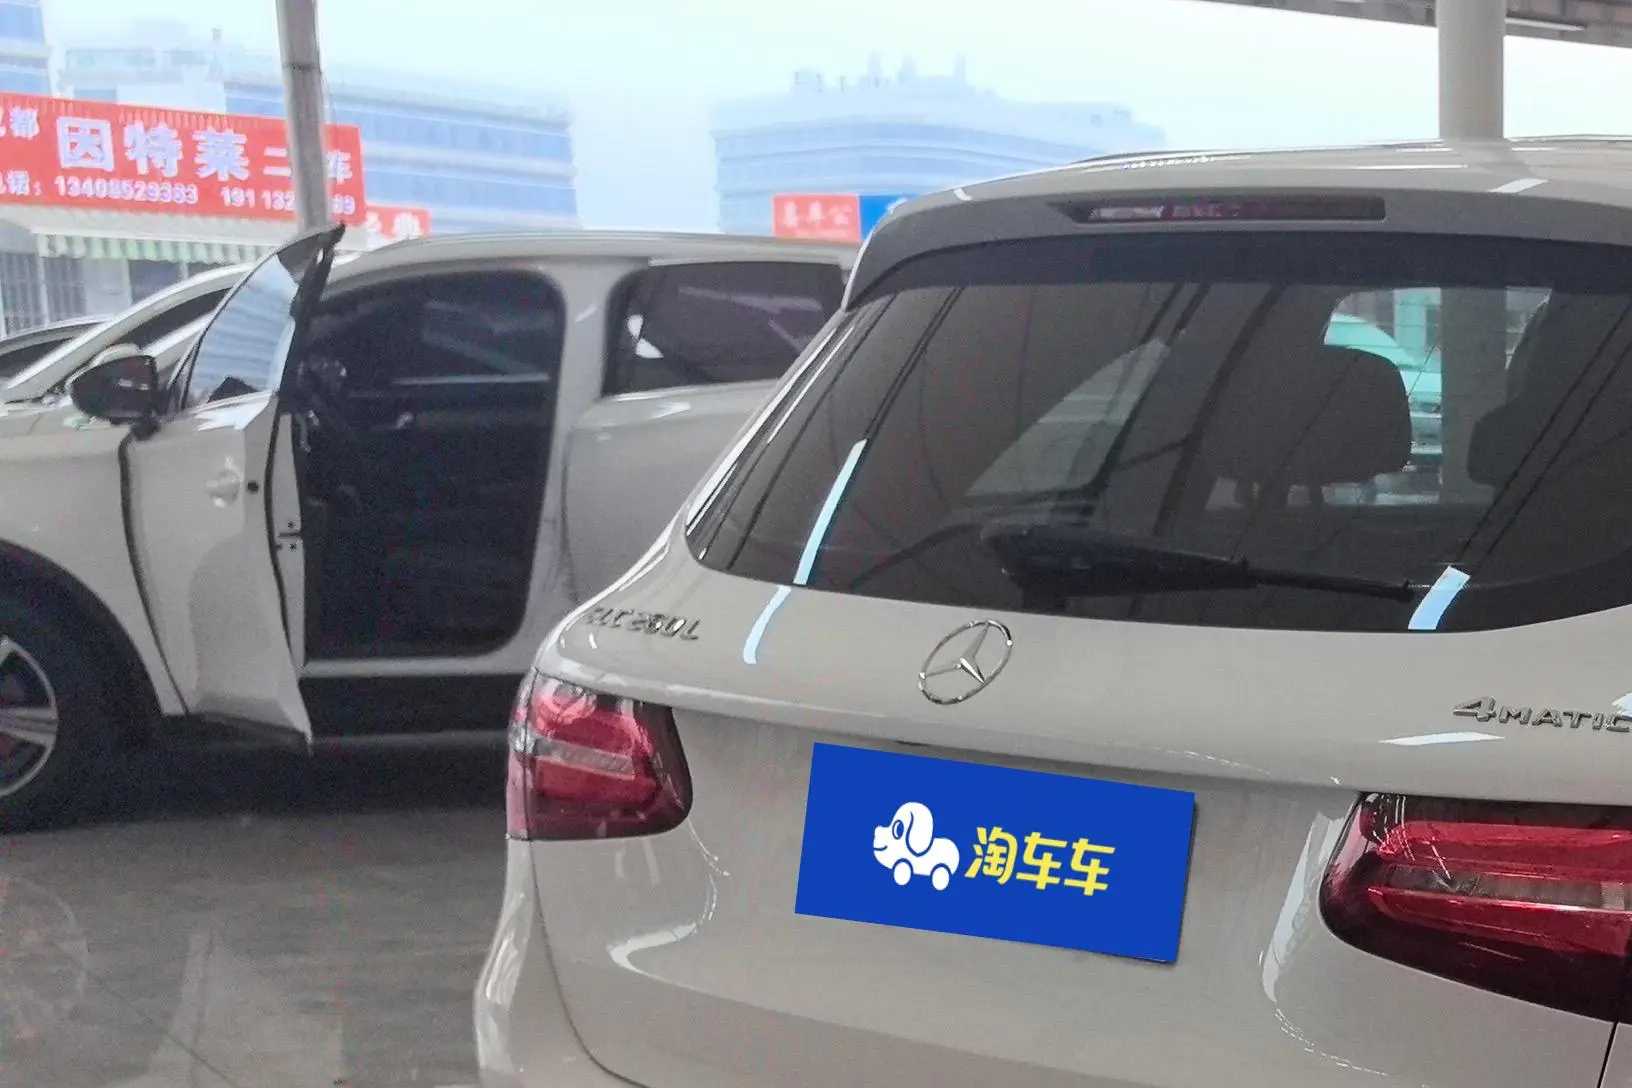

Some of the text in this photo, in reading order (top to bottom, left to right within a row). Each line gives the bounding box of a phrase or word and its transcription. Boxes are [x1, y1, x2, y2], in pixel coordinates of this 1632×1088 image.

[56, 117, 353, 184] 因特莱二车
[1453, 696, 1632, 733] 4MATIC
